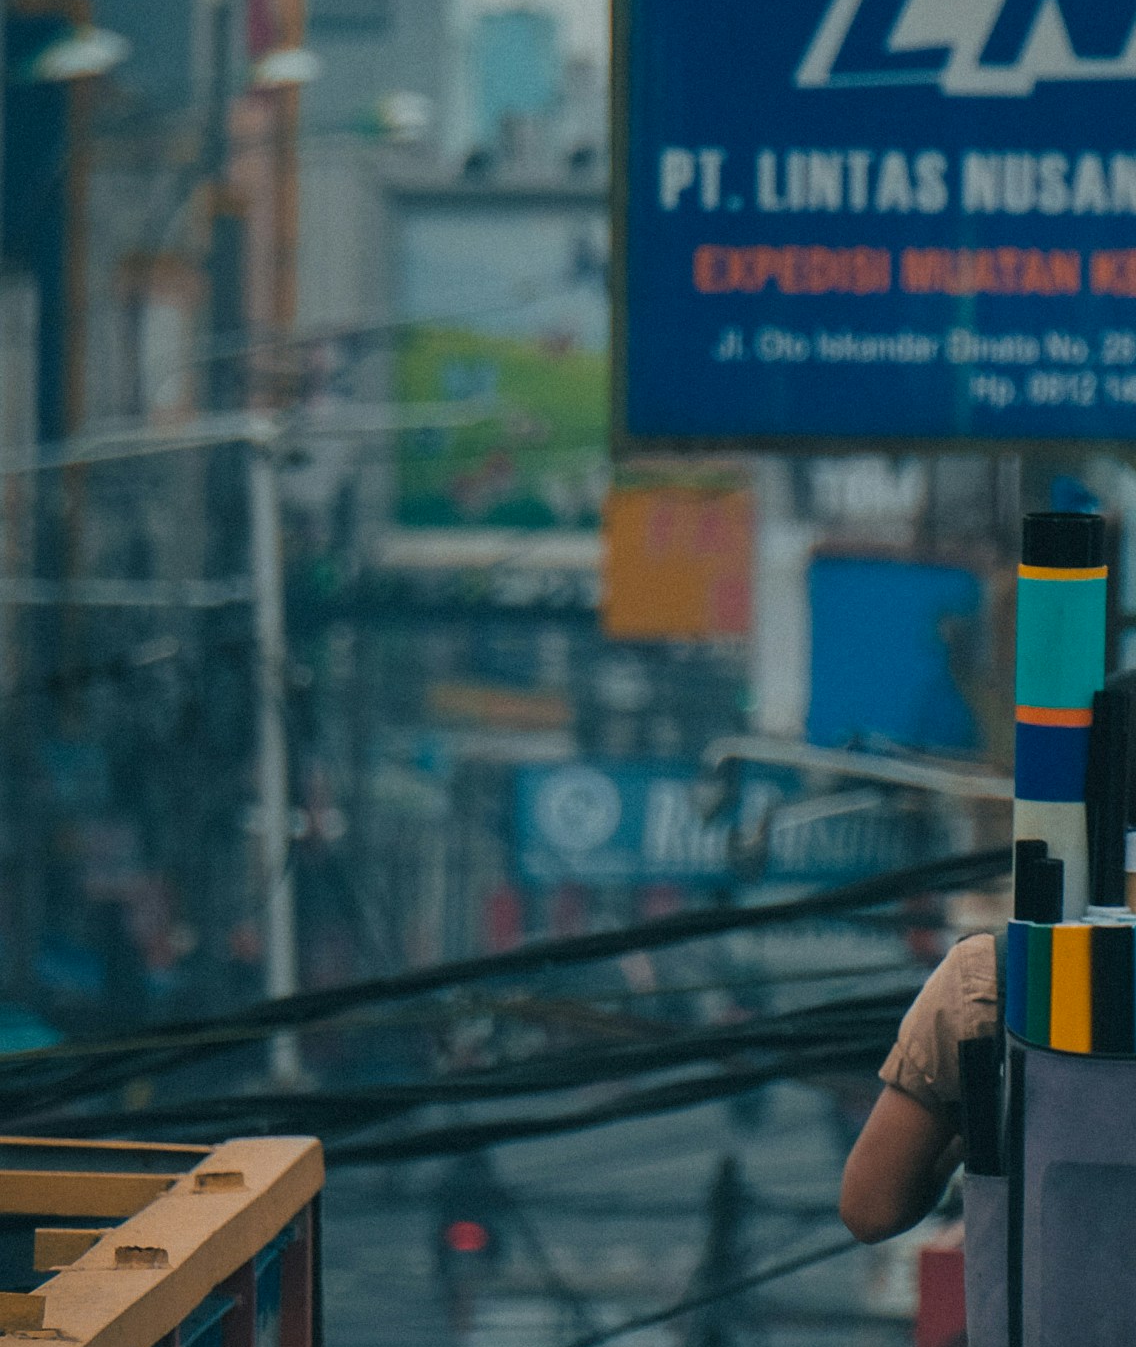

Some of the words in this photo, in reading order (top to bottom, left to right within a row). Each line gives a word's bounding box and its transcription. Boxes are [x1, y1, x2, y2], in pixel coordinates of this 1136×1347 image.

[658, 148, 744, 212] PT.
[756, 149, 950, 214] LINTAS
[693, 243, 892, 296] EXPEDISI
[900, 246, 1082, 297] MUATAN
